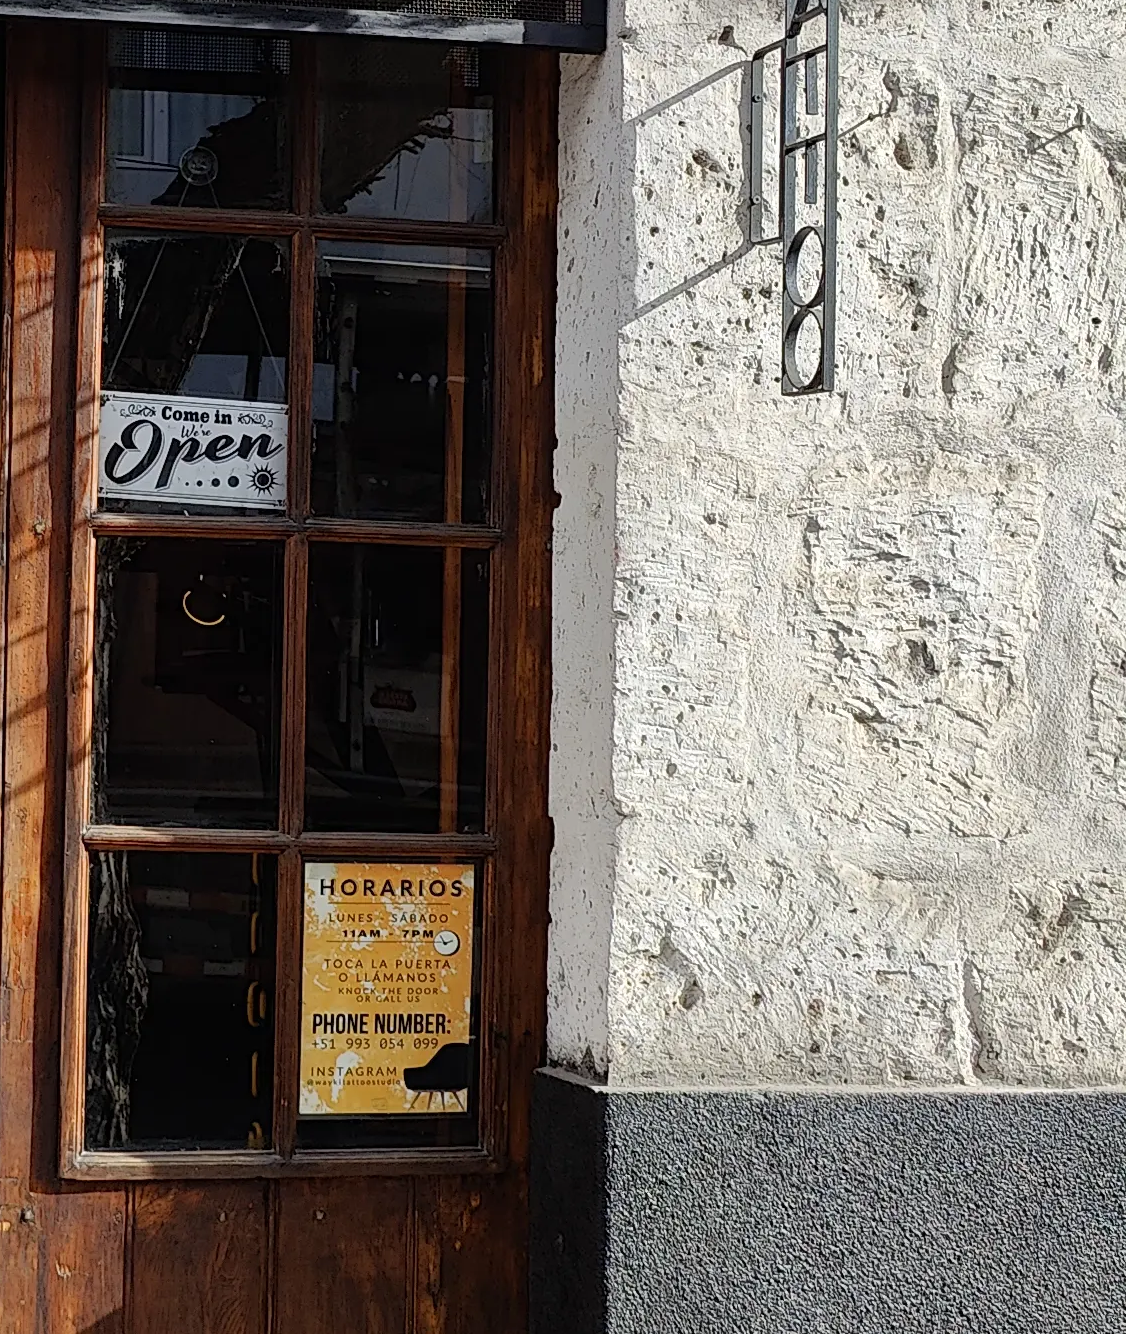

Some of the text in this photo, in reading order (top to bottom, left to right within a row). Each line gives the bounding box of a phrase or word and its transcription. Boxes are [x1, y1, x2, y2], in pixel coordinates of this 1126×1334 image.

[161, 405, 232, 425] Come in
[180, 424, 212, 439] We're
[104, 419, 286, 492] Open
[320, 878, 464, 898] HORARIOS
[328, 913, 374, 923] LUNES
[391, 911, 449, 924] SÁBADO
[342, 929, 381, 938] 11AM
[401, 929, 435, 939] 7PM
[324, 958, 452, 970] TOCA LA PUERTA
[338, 970, 437, 983] O LLÁMANOS
[338, 987, 439, 995] KNOCK THE DOOR
[356, 995, 421, 1003] OR CALL US
[312, 1013, 452, 1036] PHONE NUMBER:
[311, 1037, 439, 1050] +51 993 054 099
[310, 1066, 398, 1077] INSTAGRAM
